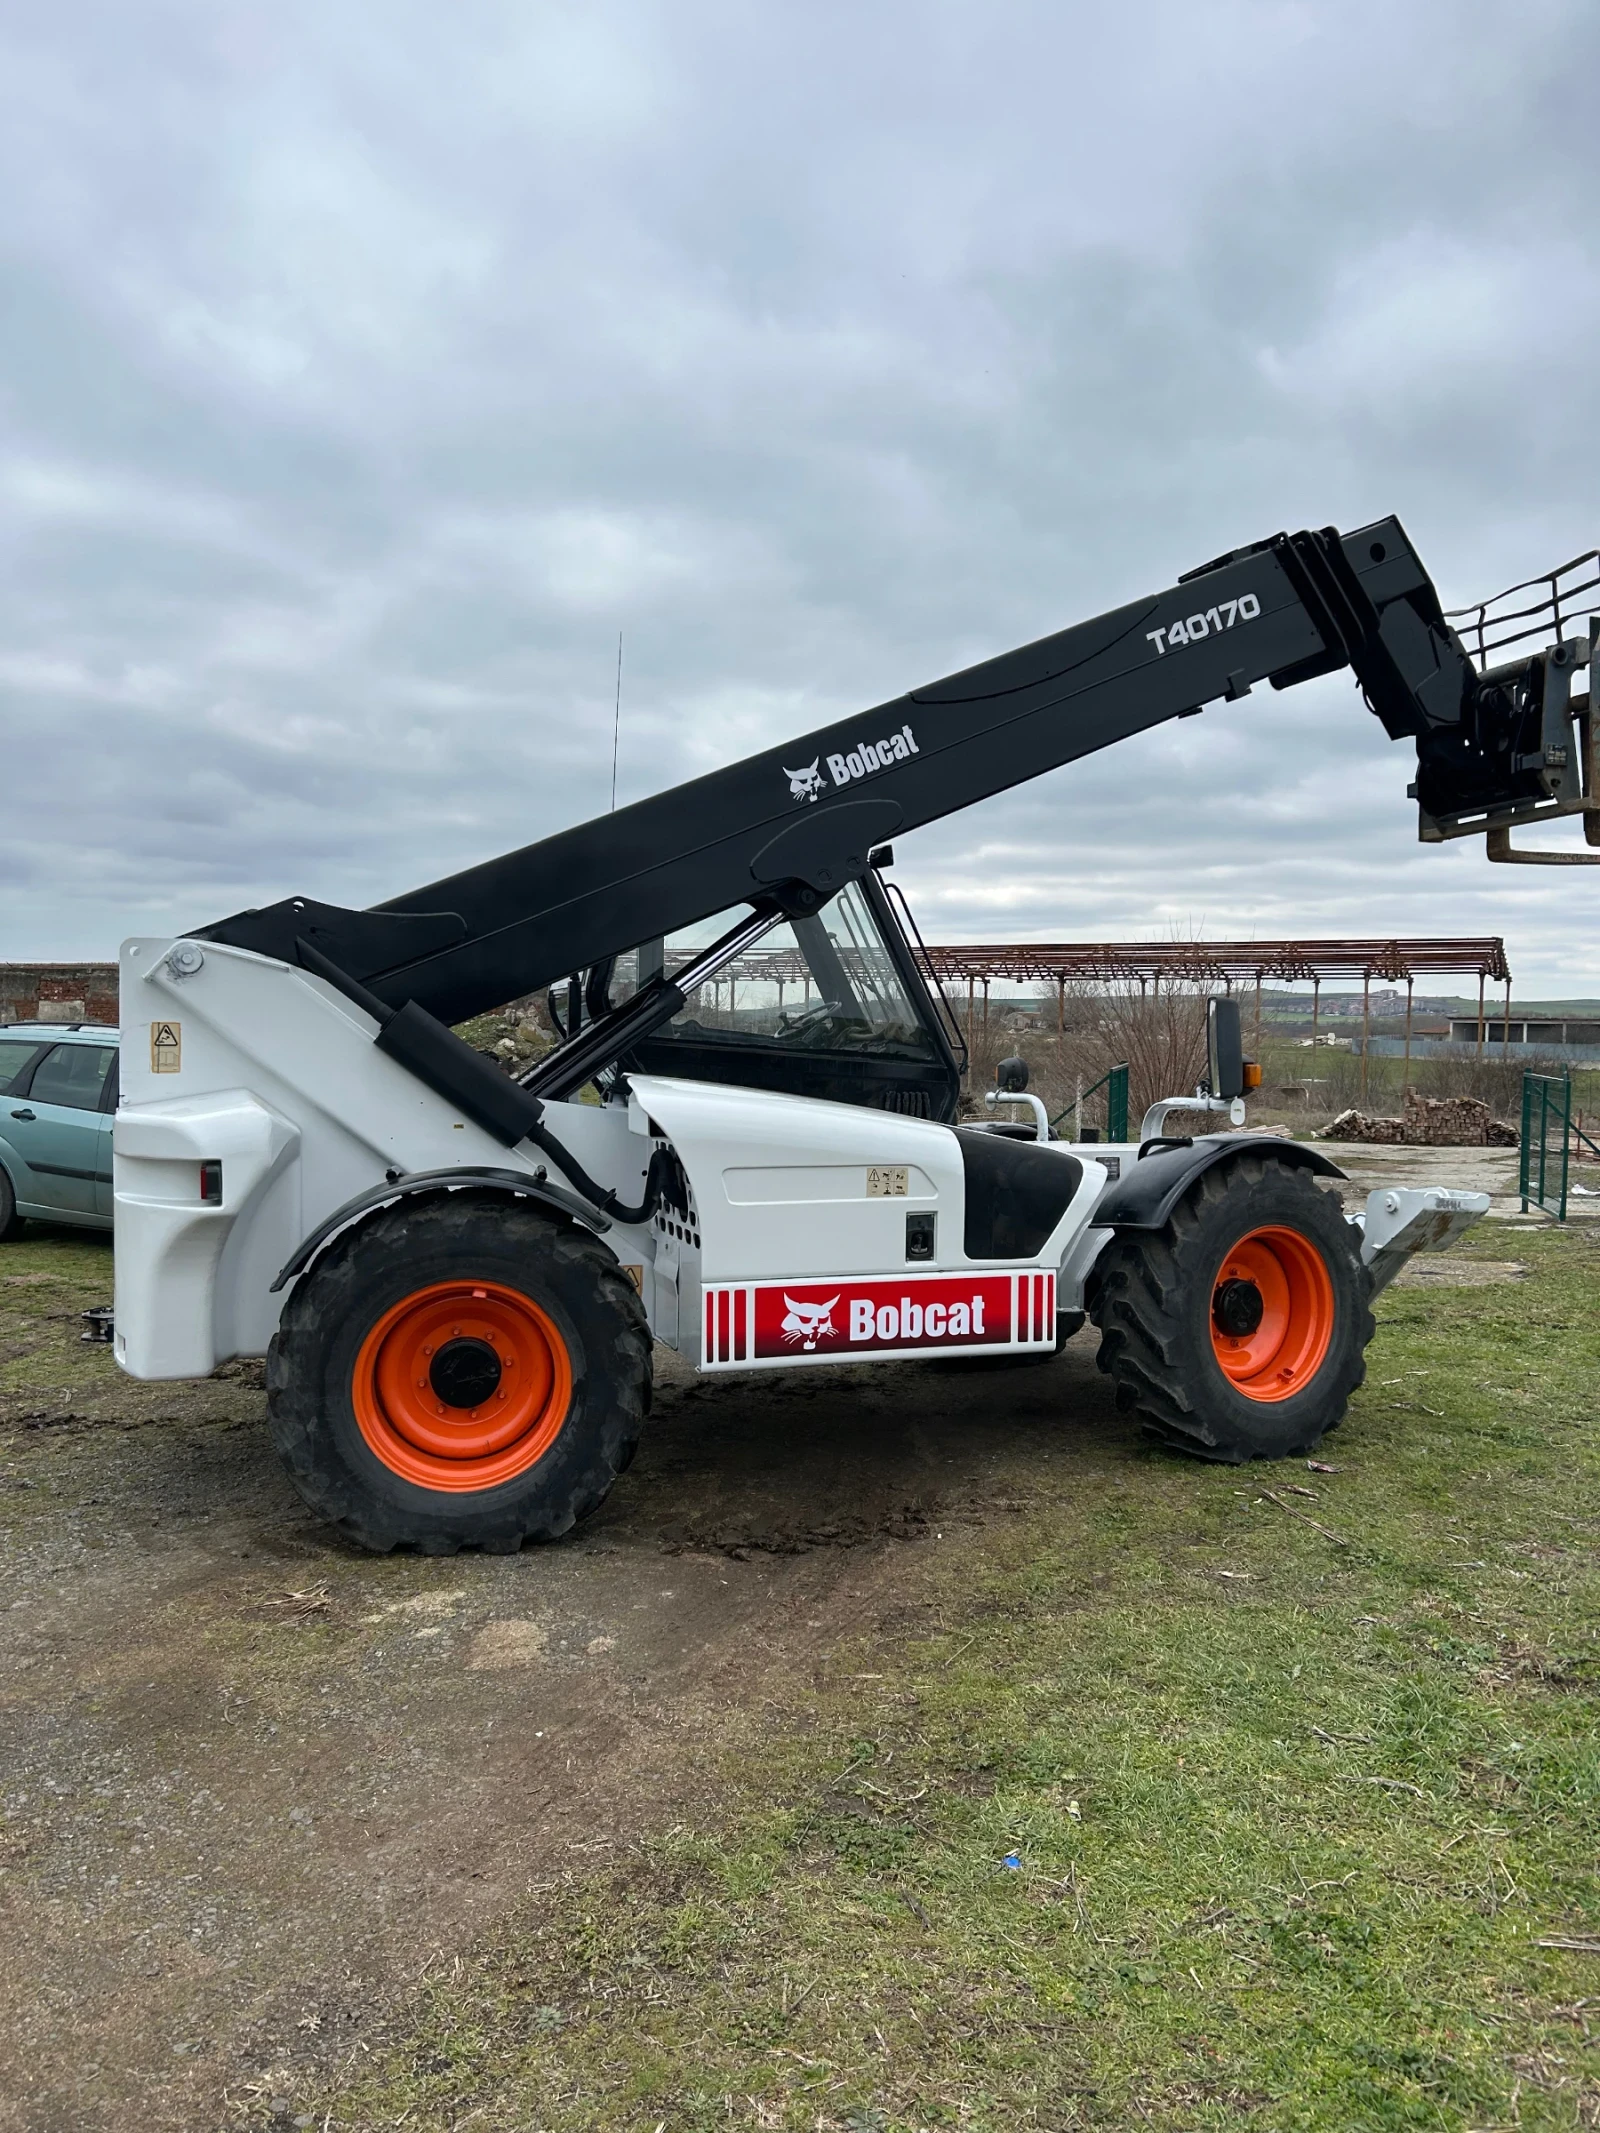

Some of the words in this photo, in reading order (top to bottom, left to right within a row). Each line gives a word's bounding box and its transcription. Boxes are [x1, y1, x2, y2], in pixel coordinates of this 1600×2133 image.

[1146, 593, 1261, 655] T40170
[826, 724, 920, 787] Bobcat
[849, 1295, 985, 1342] Bobcat
